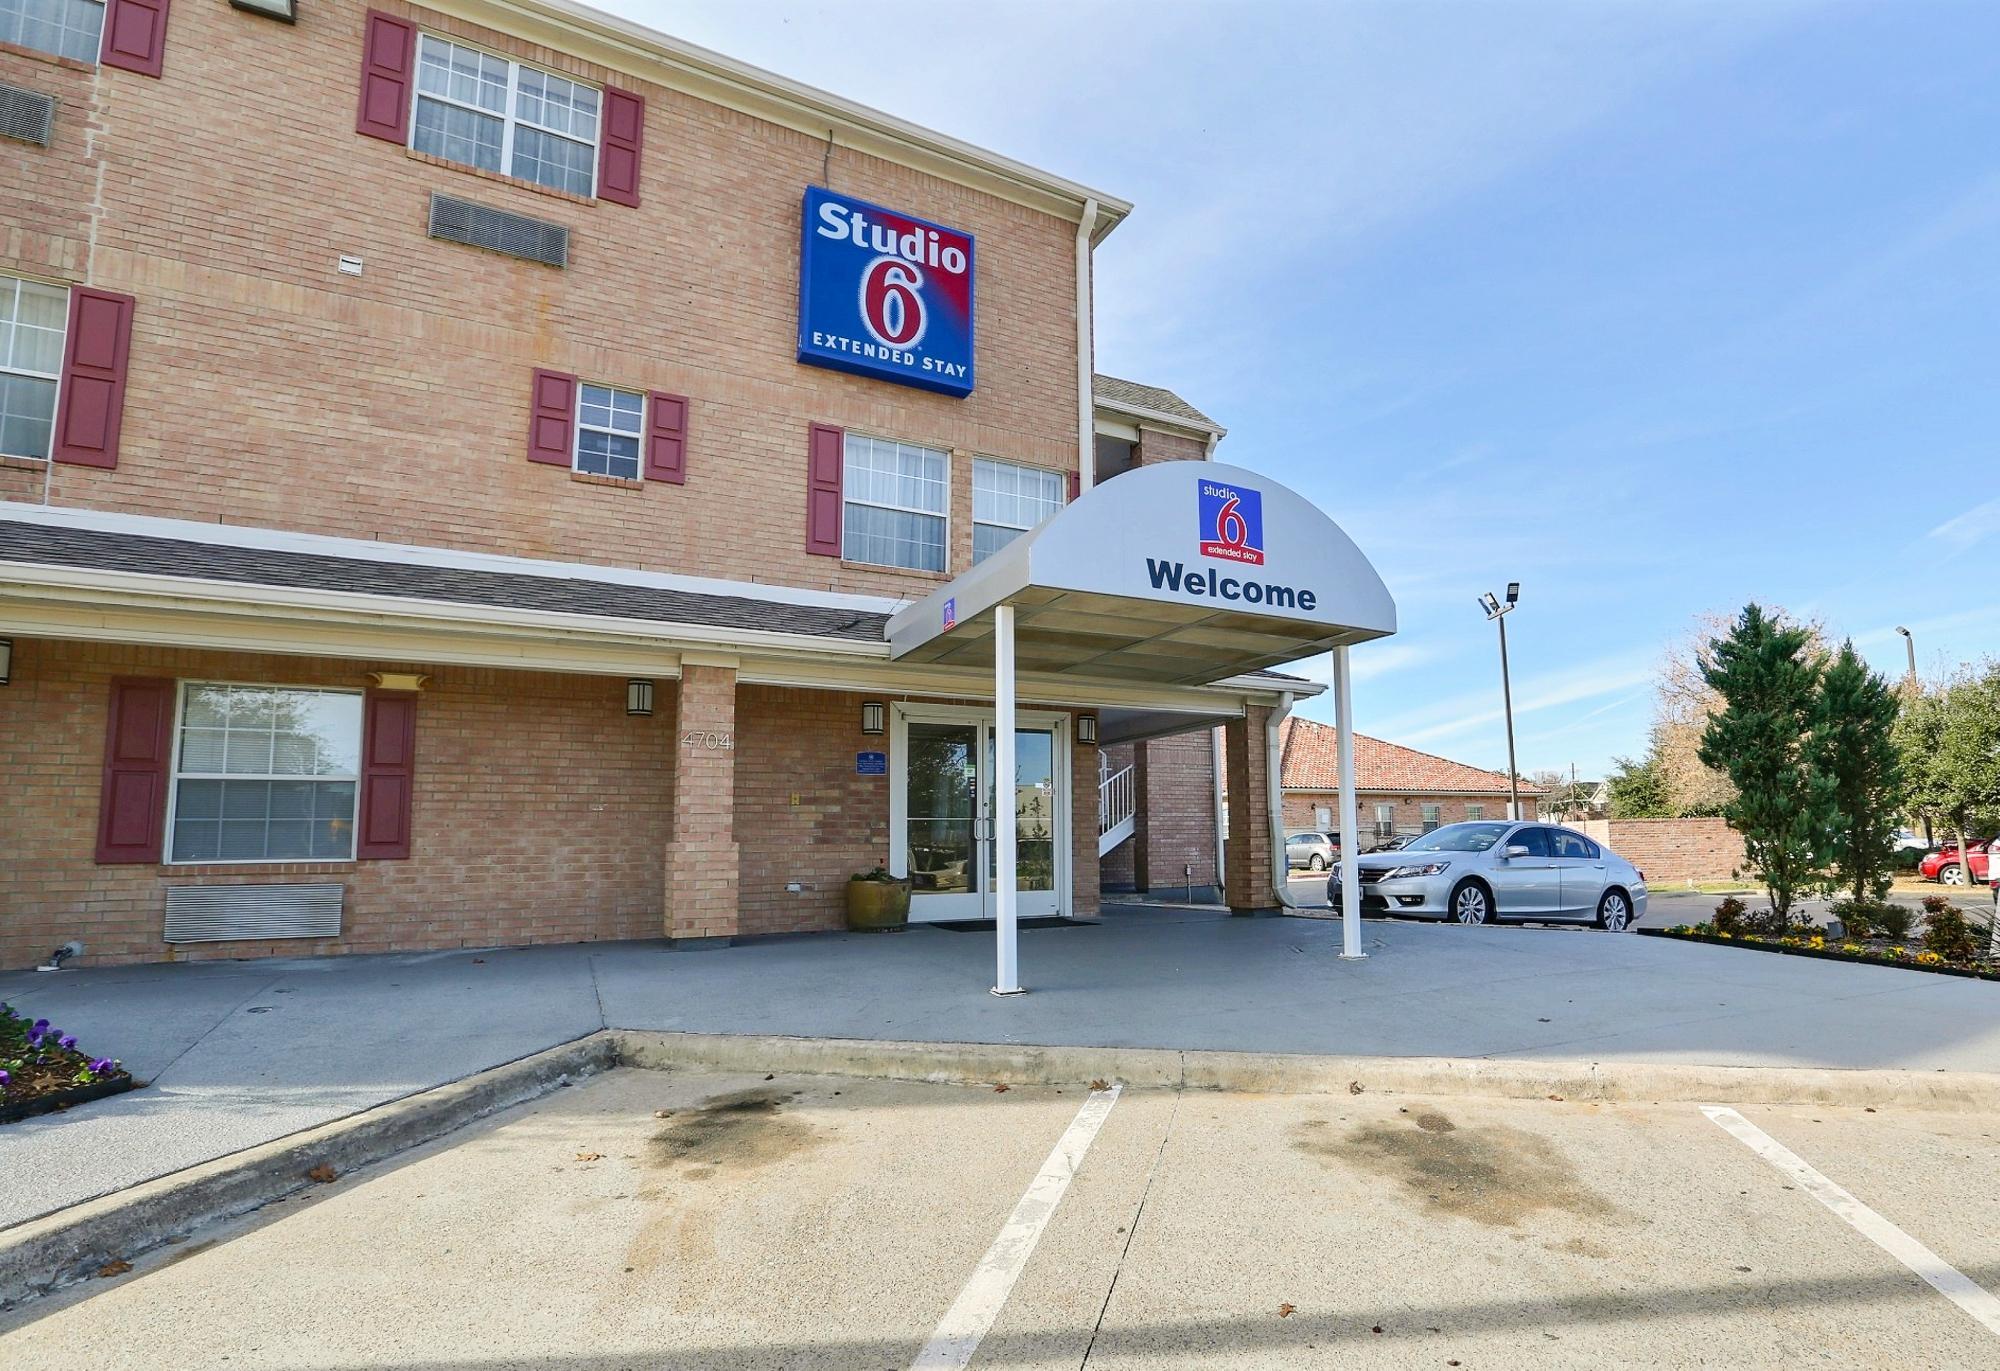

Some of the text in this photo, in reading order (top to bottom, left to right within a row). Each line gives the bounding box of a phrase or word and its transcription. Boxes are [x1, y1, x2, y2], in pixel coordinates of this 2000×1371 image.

[817, 202, 966, 274] Studio
[860, 255, 927, 349] 6
[813, 332, 966, 378] EXTENDED STAY
[1204, 485, 1237, 499] studio
[1217, 498, 1247, 546] 6
[1208, 546, 1258, 562] extended stay
[1146, 557, 1316, 611] Welcome
[681, 731, 731, 750] 4704
